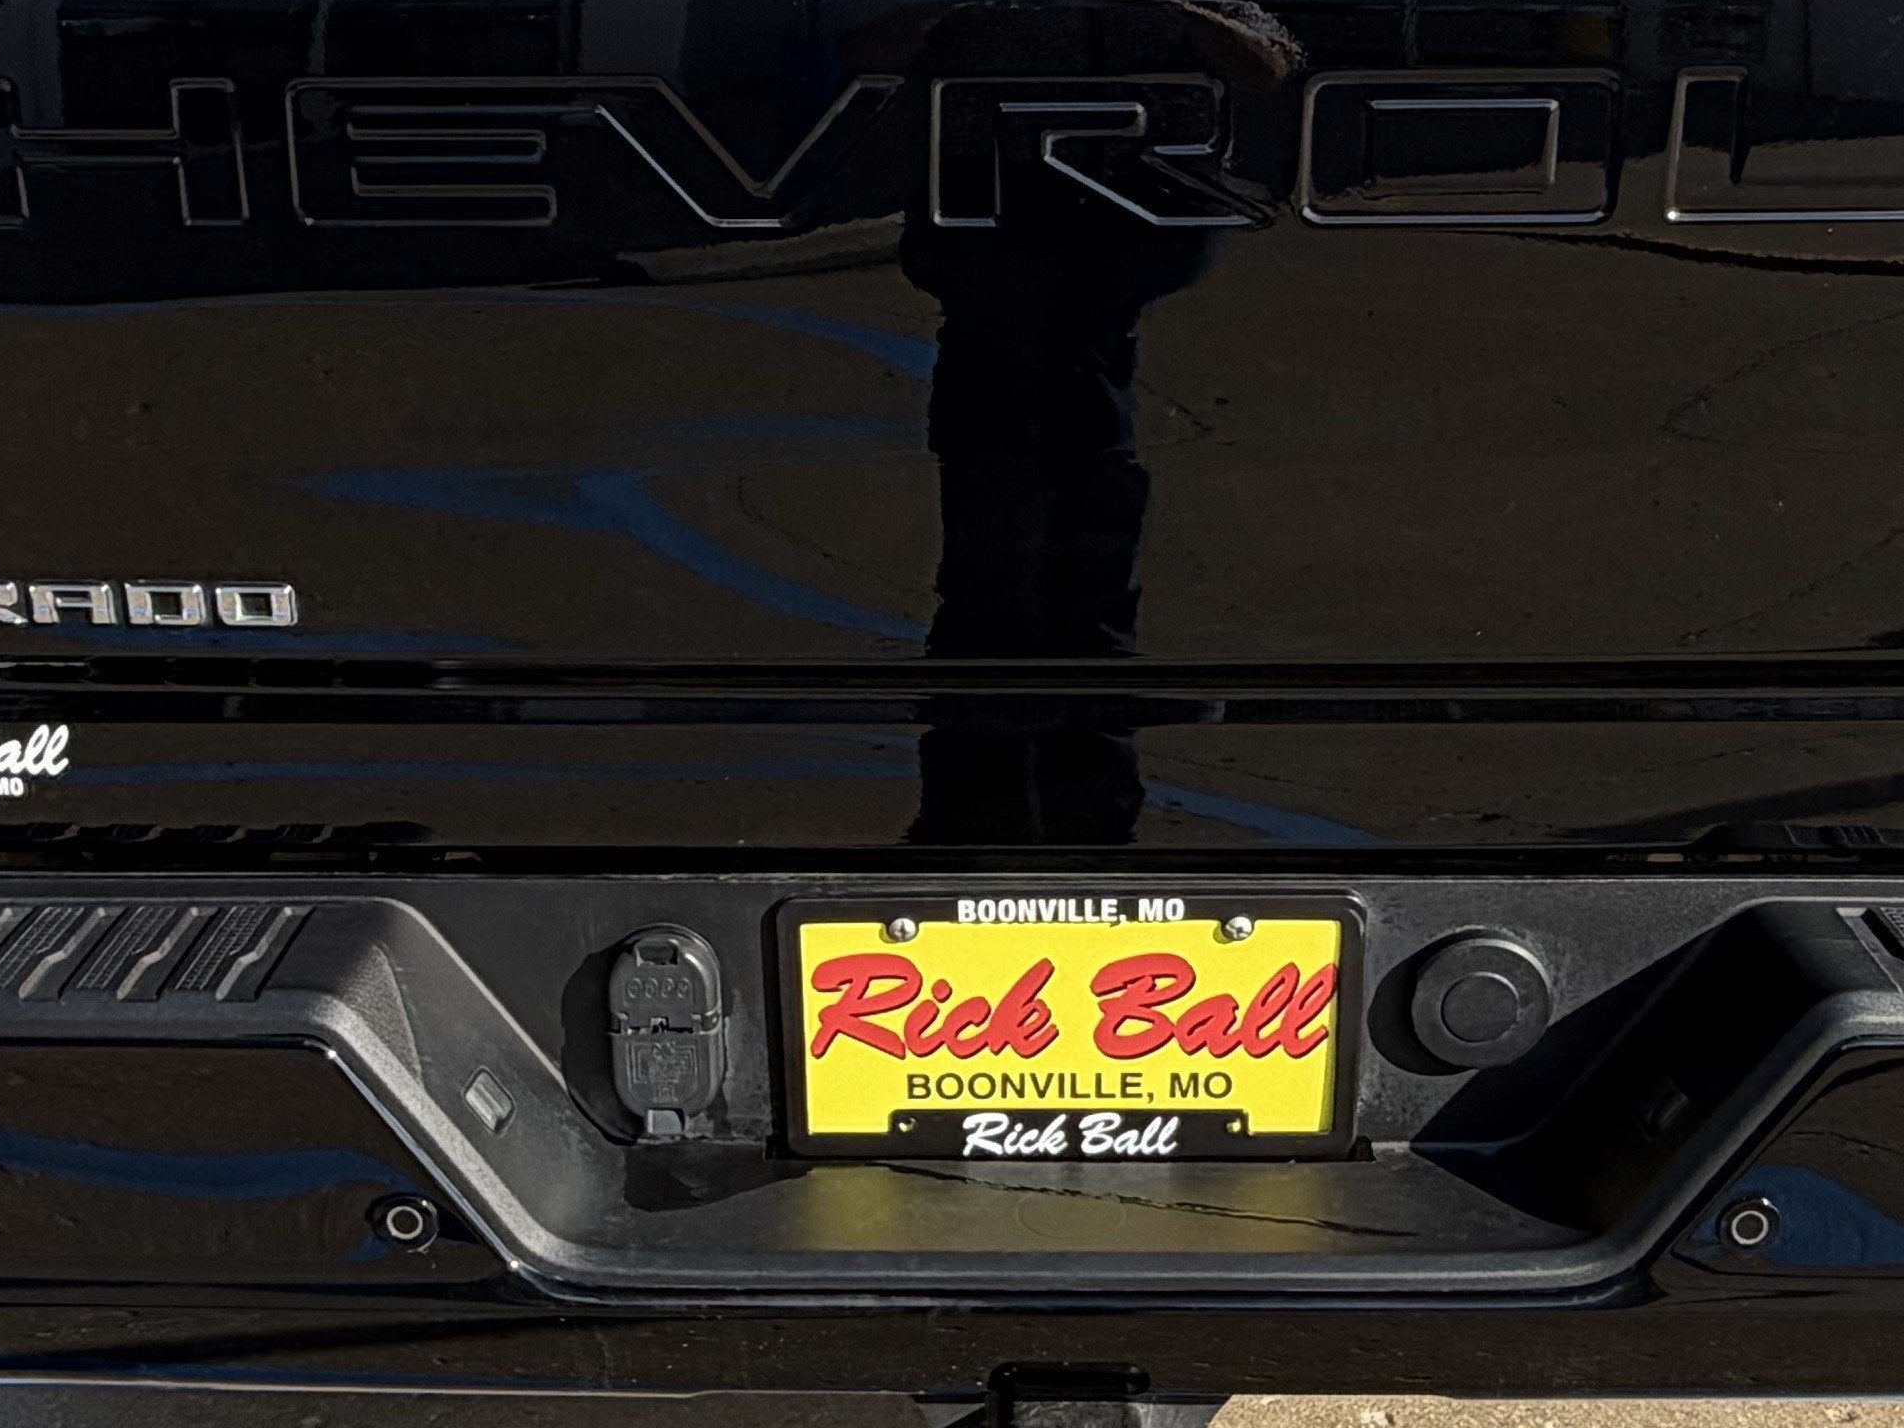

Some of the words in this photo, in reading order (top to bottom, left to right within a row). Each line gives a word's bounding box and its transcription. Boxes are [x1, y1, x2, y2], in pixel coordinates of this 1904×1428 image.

[956, 897, 1127, 924] BOONVILLE,
[1137, 897, 1185, 922] MO
[809, 952, 1060, 1060] Rick
[1089, 952, 1339, 1060] Ball
[906, 1071, 1155, 1104] BOONVILLE,
[1169, 1070, 1233, 1100] MO
[962, 1112, 1068, 1157] Rick
[1080, 1114, 1178, 1157] Ball
